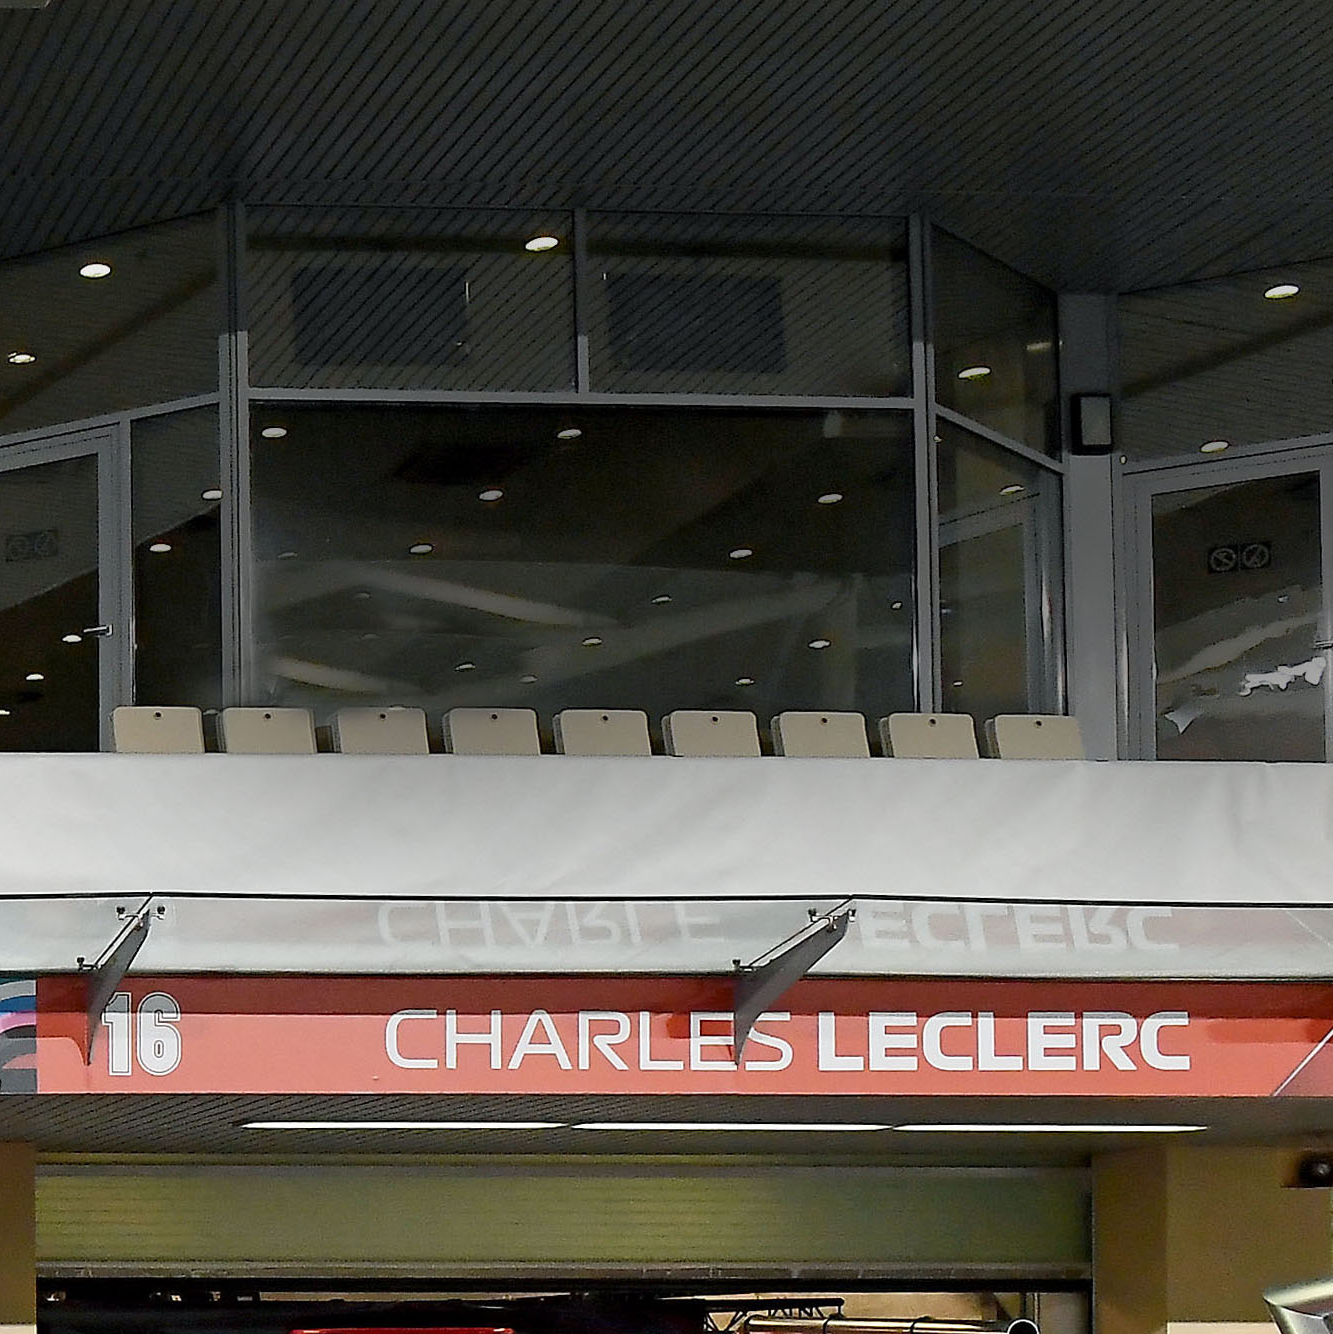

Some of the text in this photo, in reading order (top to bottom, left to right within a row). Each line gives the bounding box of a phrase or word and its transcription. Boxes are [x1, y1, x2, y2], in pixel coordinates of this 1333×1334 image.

[102, 992, 183, 1077] 16
[384, 1009, 1191, 1073] CHARLES LECLERC
